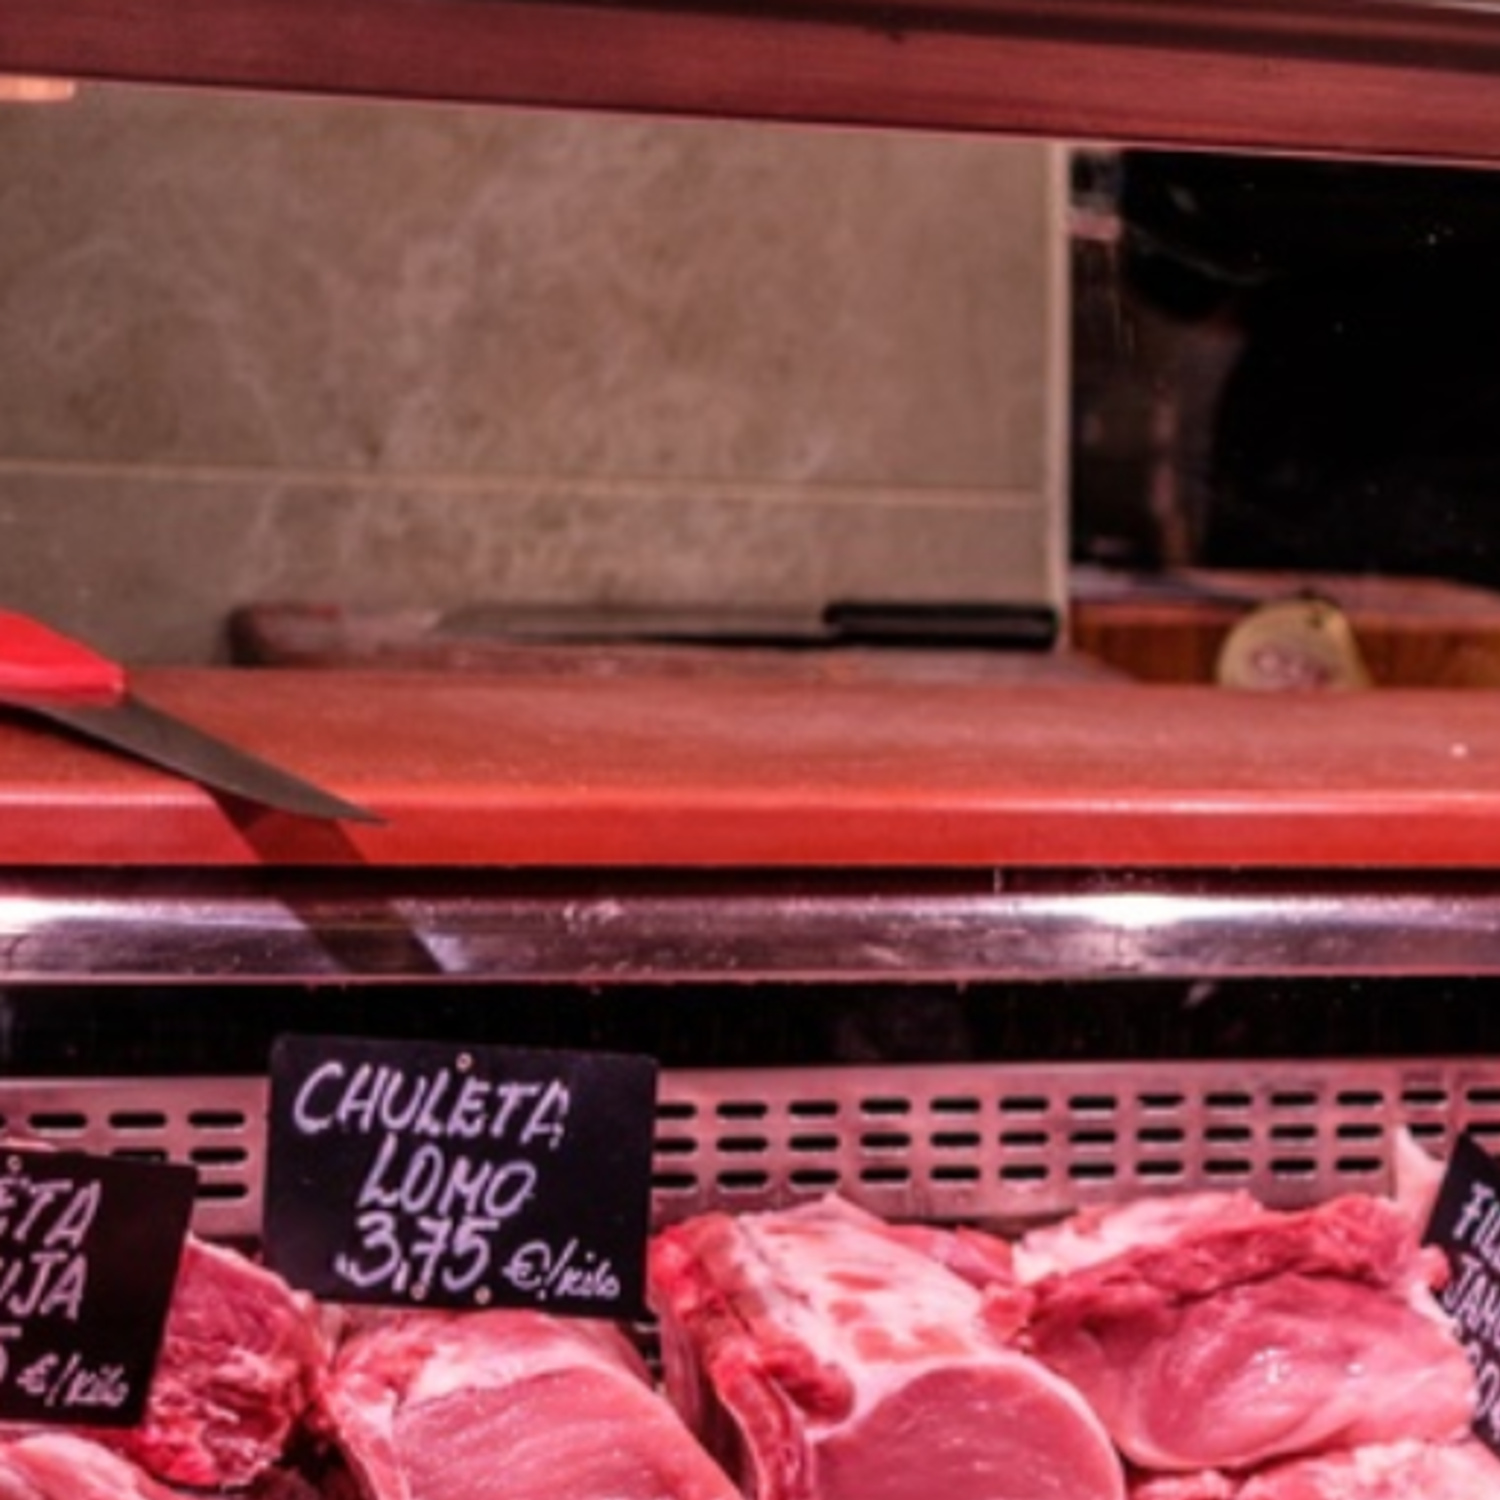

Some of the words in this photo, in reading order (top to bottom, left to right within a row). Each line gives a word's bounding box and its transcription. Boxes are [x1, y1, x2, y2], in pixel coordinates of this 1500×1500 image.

[292, 1061, 571, 1148] CHULETA
[357, 1134, 538, 1219] LOMO
[334, 1210, 499, 1292] 3,75
